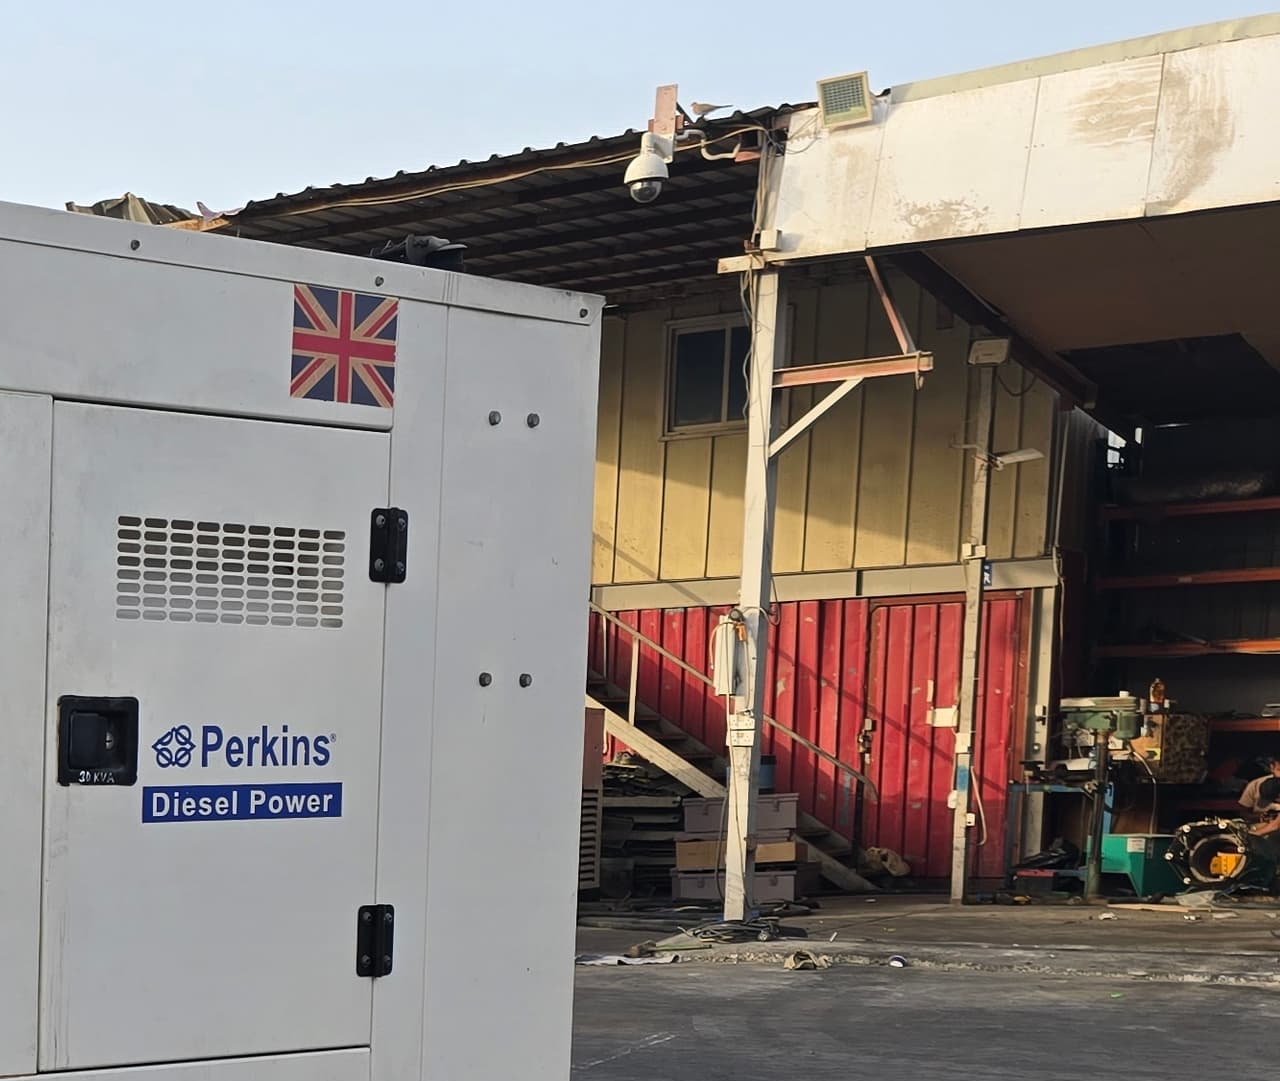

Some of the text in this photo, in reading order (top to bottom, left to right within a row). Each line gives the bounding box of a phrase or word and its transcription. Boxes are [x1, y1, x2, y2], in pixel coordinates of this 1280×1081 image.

[201, 725, 332, 769] Perkins
[93, 772, 115, 783] KVA
[152, 789, 333, 818] Diesel Power
